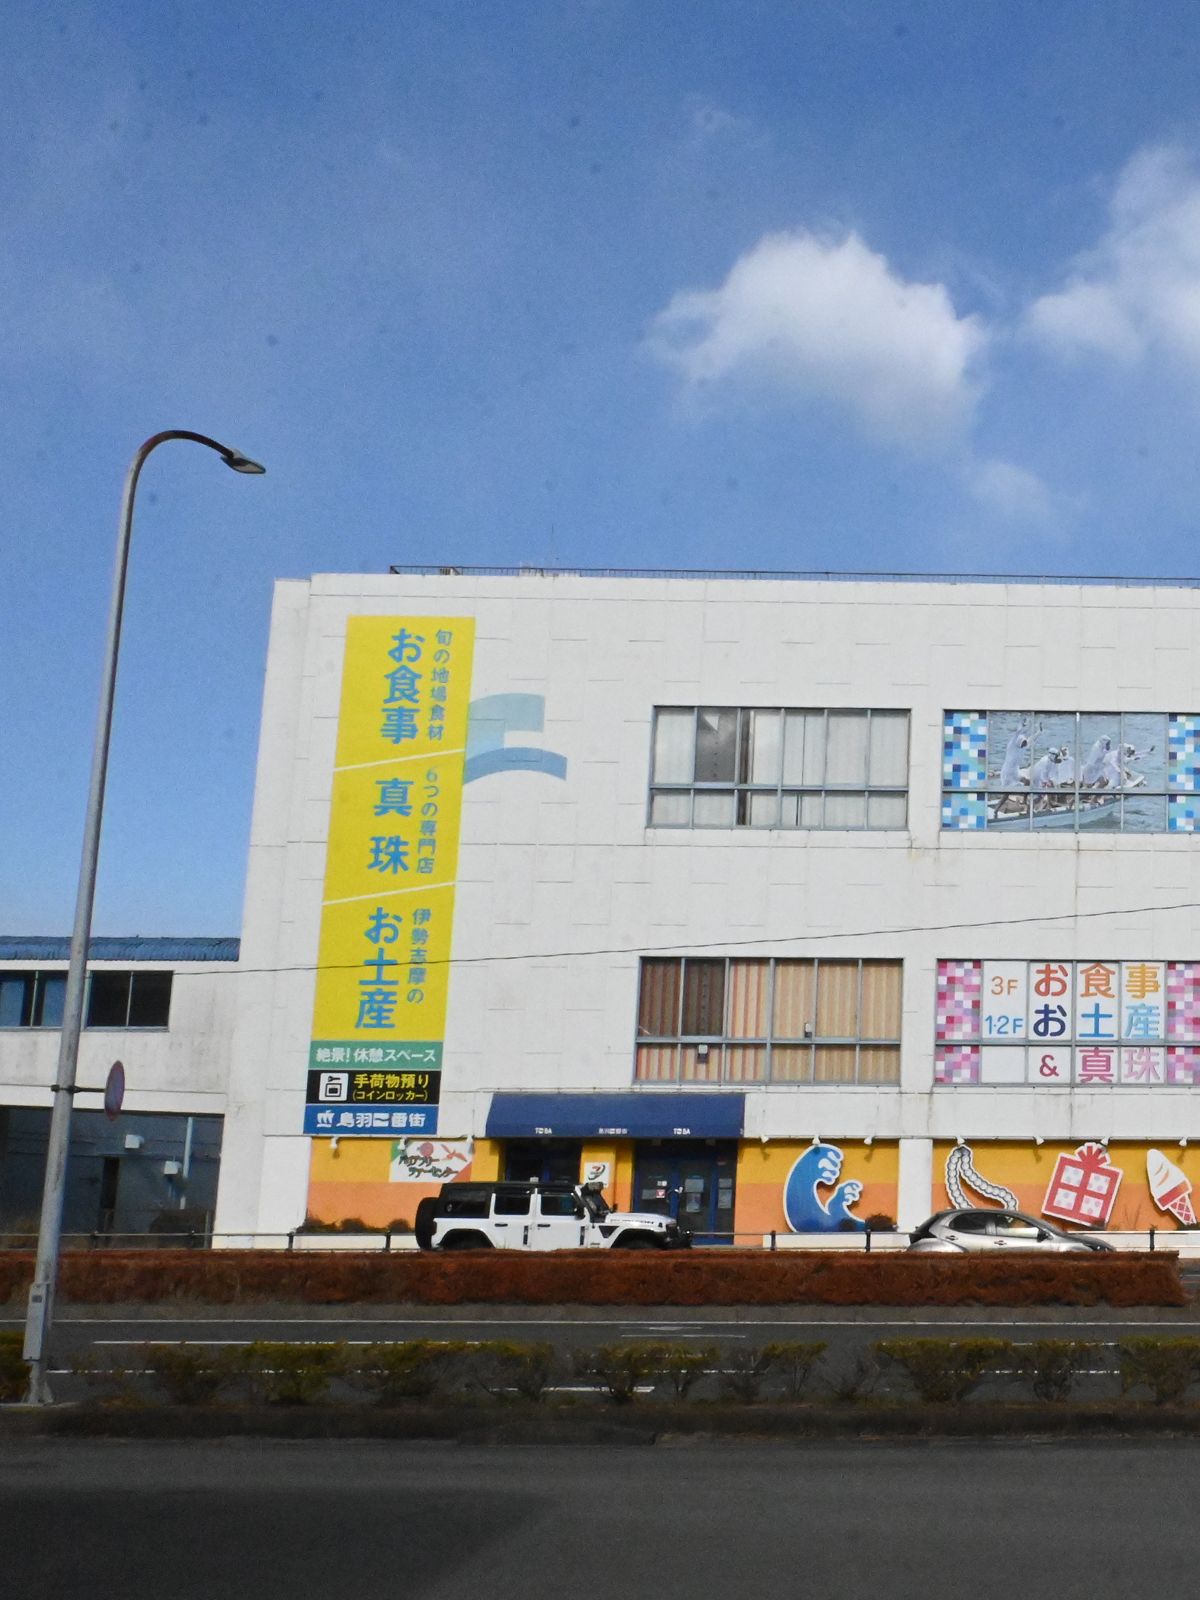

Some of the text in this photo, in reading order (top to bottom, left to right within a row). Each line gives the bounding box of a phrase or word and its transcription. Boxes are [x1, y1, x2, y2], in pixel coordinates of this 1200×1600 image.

[380, 628, 426, 744] お食事
[427, 629, 453, 741] 旬の地場食材
[367, 777, 414, 874] 真珠
[355, 907, 403, 1029] お土産
[991, 962, 1160, 999] 3F お食事
[1033, 1002, 1160, 1040] お土産
[353, 1073, 430, 1089] 手荷物預り
[1039, 1047, 1160, 1083] & 真珠
